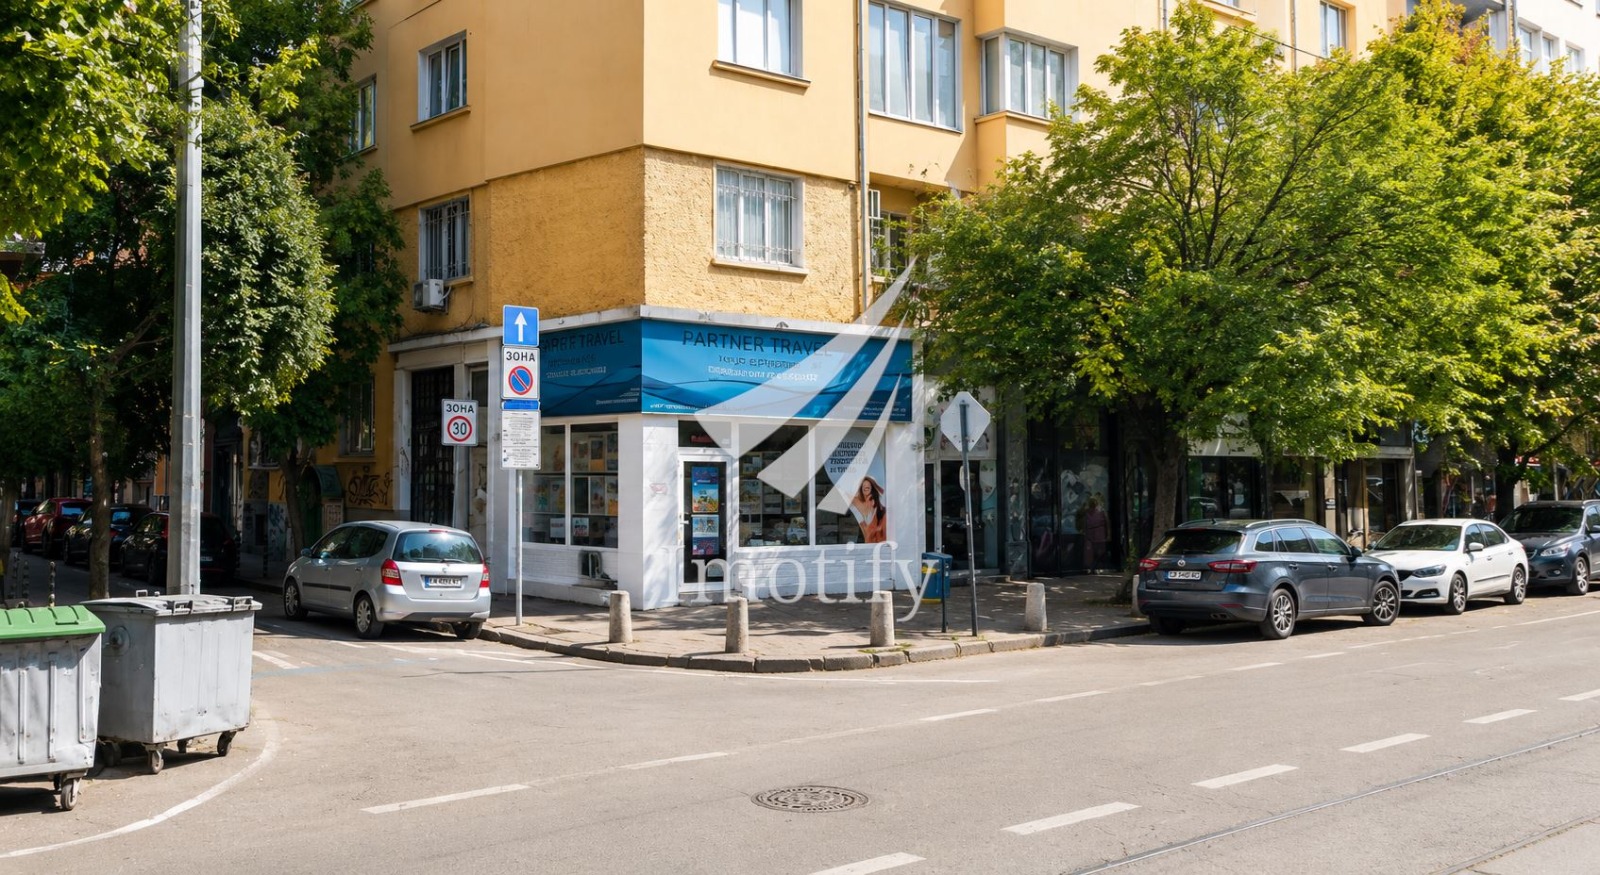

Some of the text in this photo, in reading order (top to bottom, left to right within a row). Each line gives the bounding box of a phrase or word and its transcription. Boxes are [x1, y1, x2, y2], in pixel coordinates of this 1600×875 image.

[578, 329, 625, 348] TRAVEL
[682, 329, 833, 357] PARTNER TRAVEL
[506, 351, 536, 362] ЗОНА
[446, 403, 474, 414] ЗОНА
[452, 422, 467, 435] 30
